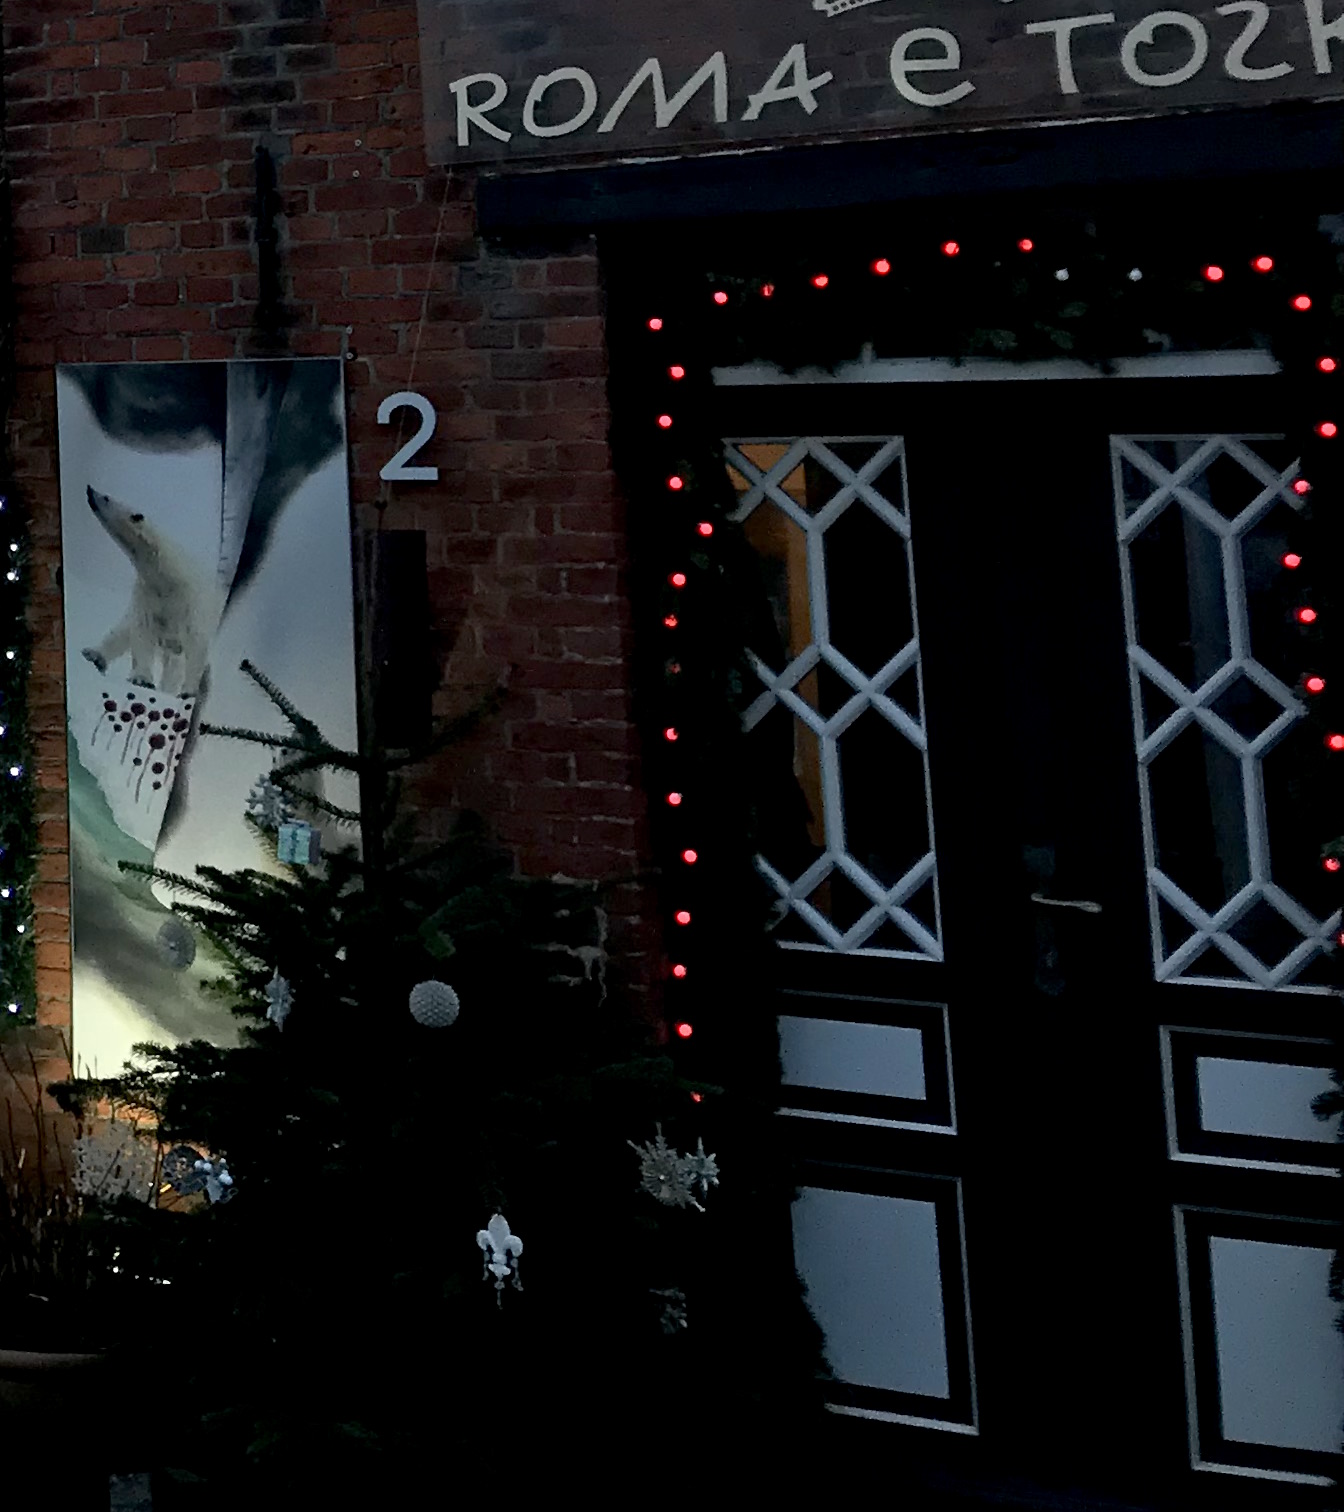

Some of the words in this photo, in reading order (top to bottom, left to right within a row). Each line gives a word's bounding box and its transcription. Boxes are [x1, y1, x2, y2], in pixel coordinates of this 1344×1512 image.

[448, 50, 834, 147] ROMA
[889, 27, 976, 107] e
[376, 391, 439, 481] 2
